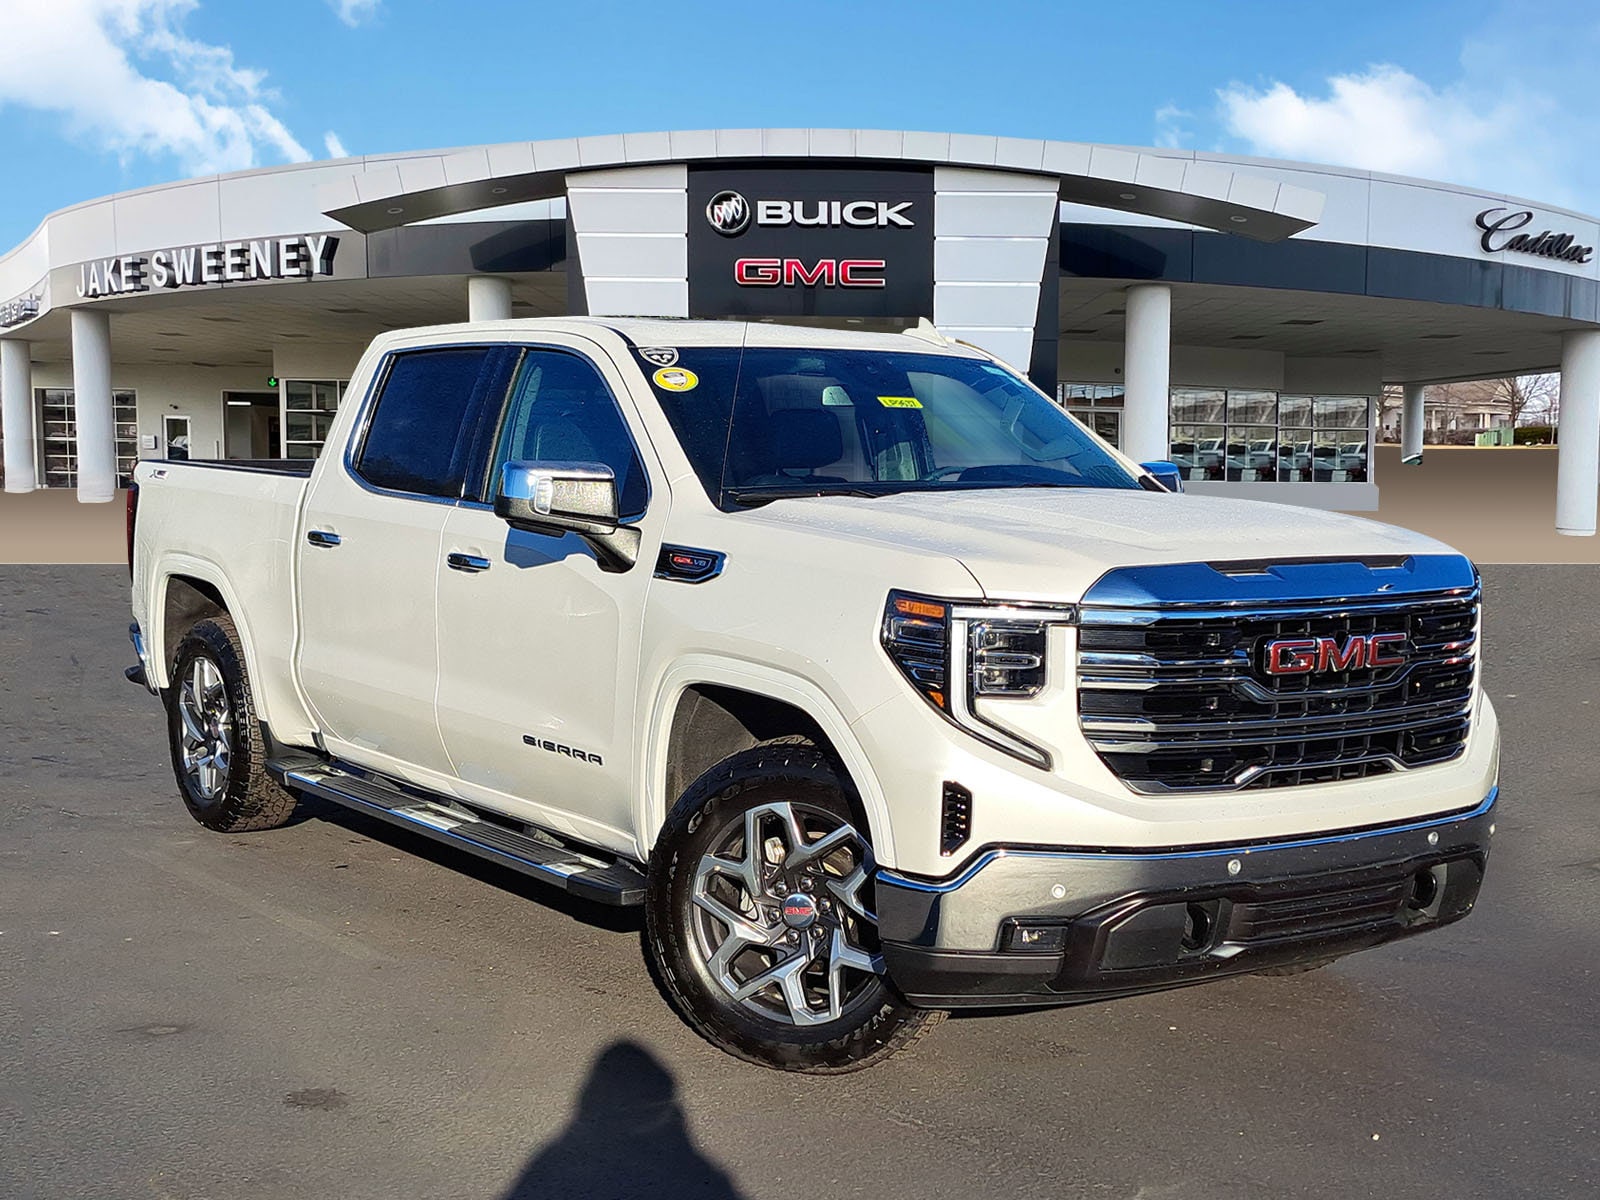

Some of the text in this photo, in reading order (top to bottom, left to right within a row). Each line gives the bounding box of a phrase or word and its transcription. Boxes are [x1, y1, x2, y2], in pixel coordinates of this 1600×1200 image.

[757, 200, 915, 228] BUICK
[1475, 207, 1593, 263] Cadillac
[75, 234, 340, 298] JAKE SWEENEY
[735, 258, 886, 286] GMC
[1265, 632, 1407, 675] GMC
[522, 734, 604, 766] SIERRA
